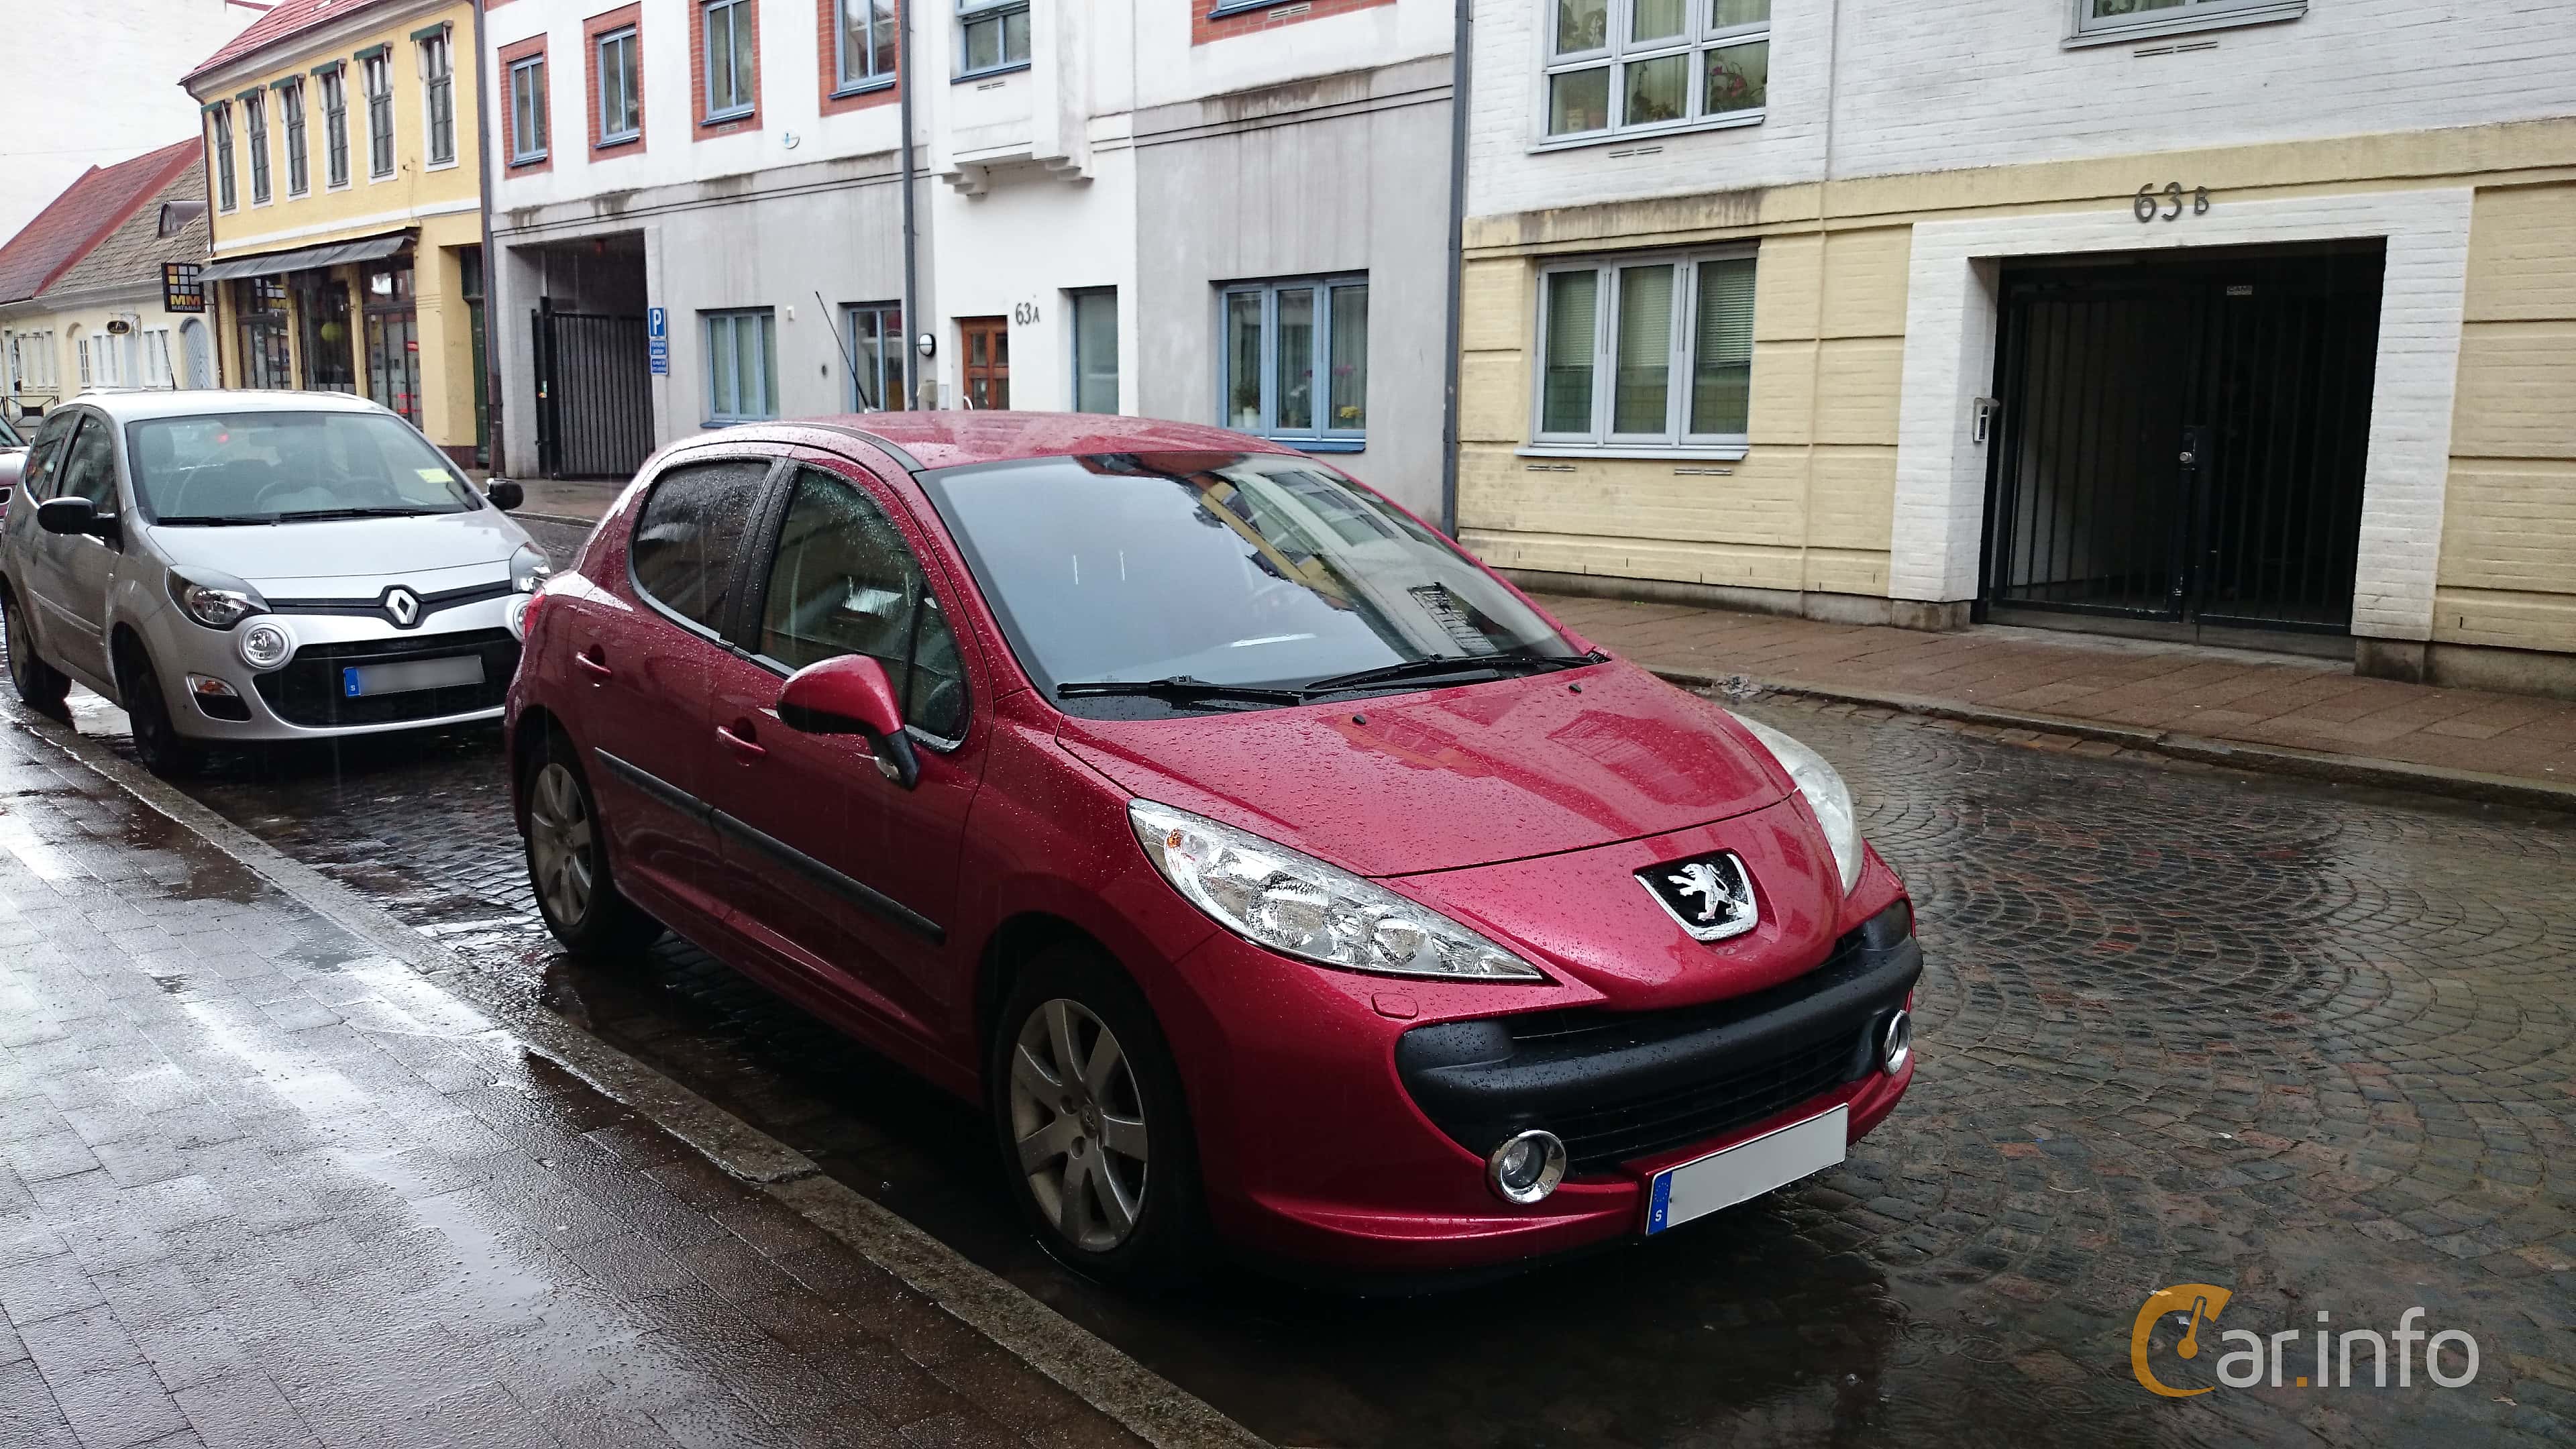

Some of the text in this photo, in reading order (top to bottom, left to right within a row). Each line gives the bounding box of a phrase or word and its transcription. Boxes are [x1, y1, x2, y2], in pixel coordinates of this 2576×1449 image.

[171, 294, 201, 305] MM
[653, 309, 662, 335] P
[1015, 302, 1040, 325] 63A
[1655, 1209, 1662, 1222] S
